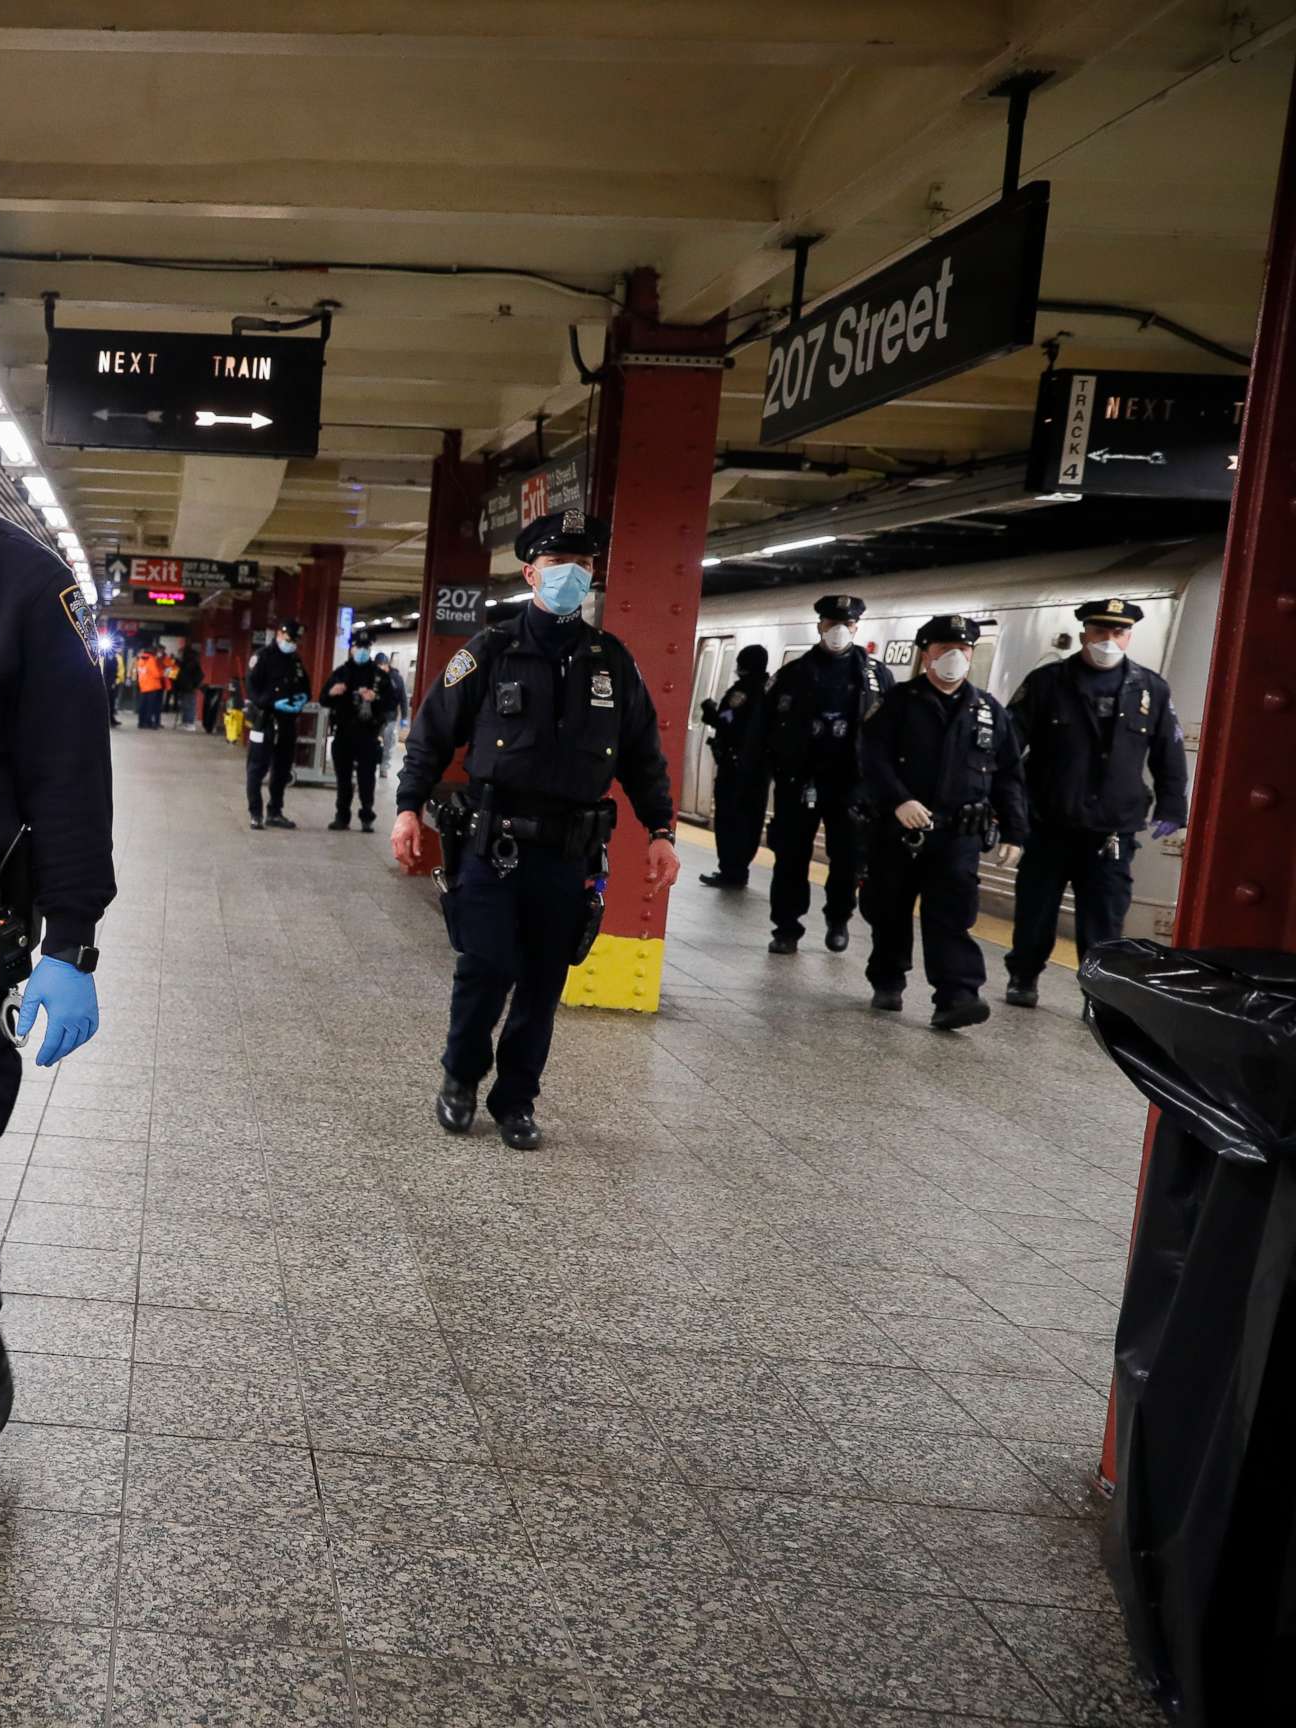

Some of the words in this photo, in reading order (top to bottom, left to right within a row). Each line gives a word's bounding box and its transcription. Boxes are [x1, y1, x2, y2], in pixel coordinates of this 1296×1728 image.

[762, 321, 827, 419] 207
[828, 256, 954, 388] Street
[98, 350, 158, 375] NEXT
[212, 355, 272, 380] TRAIN
[1068, 380, 1089, 456] TRACK
[1105, 396, 1175, 420] NEXT
[1062, 463, 1079, 480] 4
[520, 478, 547, 529] Exit
[129, 559, 179, 583] Exit
[437, 588, 481, 609] 207
[435, 608, 476, 622] Street
